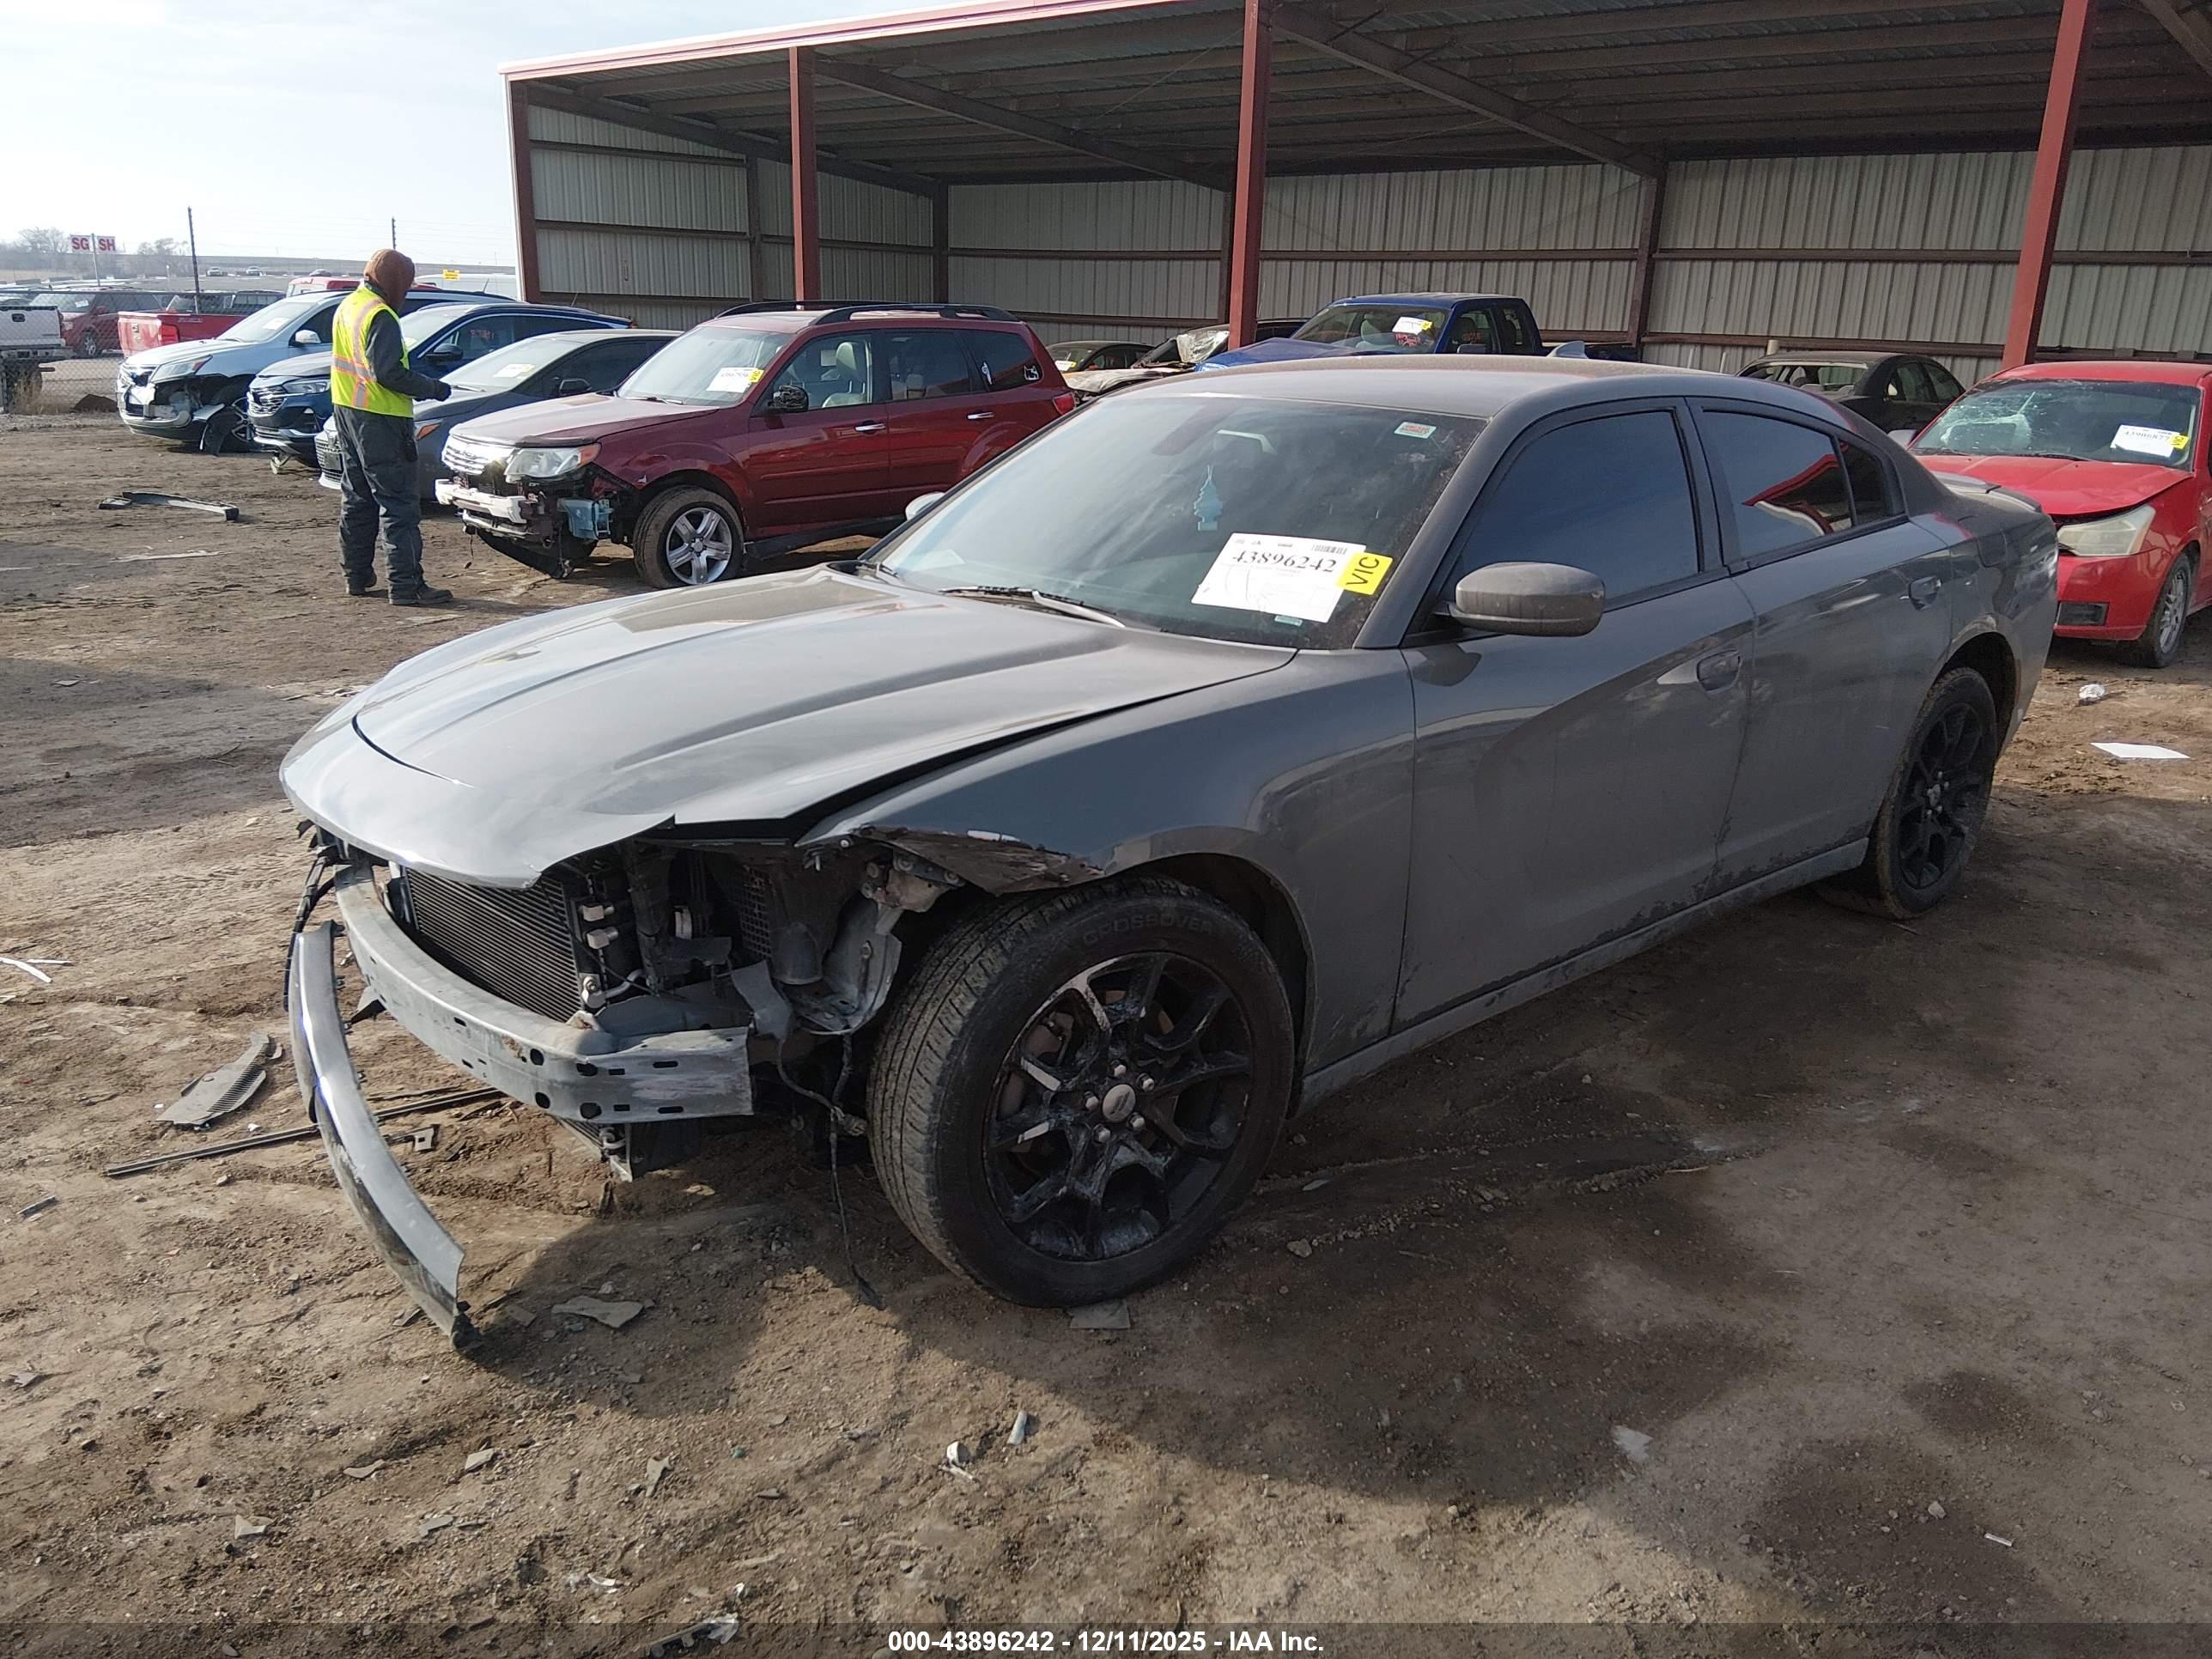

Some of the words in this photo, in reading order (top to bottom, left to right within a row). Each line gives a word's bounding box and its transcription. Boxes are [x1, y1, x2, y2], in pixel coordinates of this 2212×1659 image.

[71, 237, 90, 251] SG
[99, 238, 116, 251] SH
[1232, 550, 1338, 573] 43896242
[1346, 556, 1380, 586] VIC
